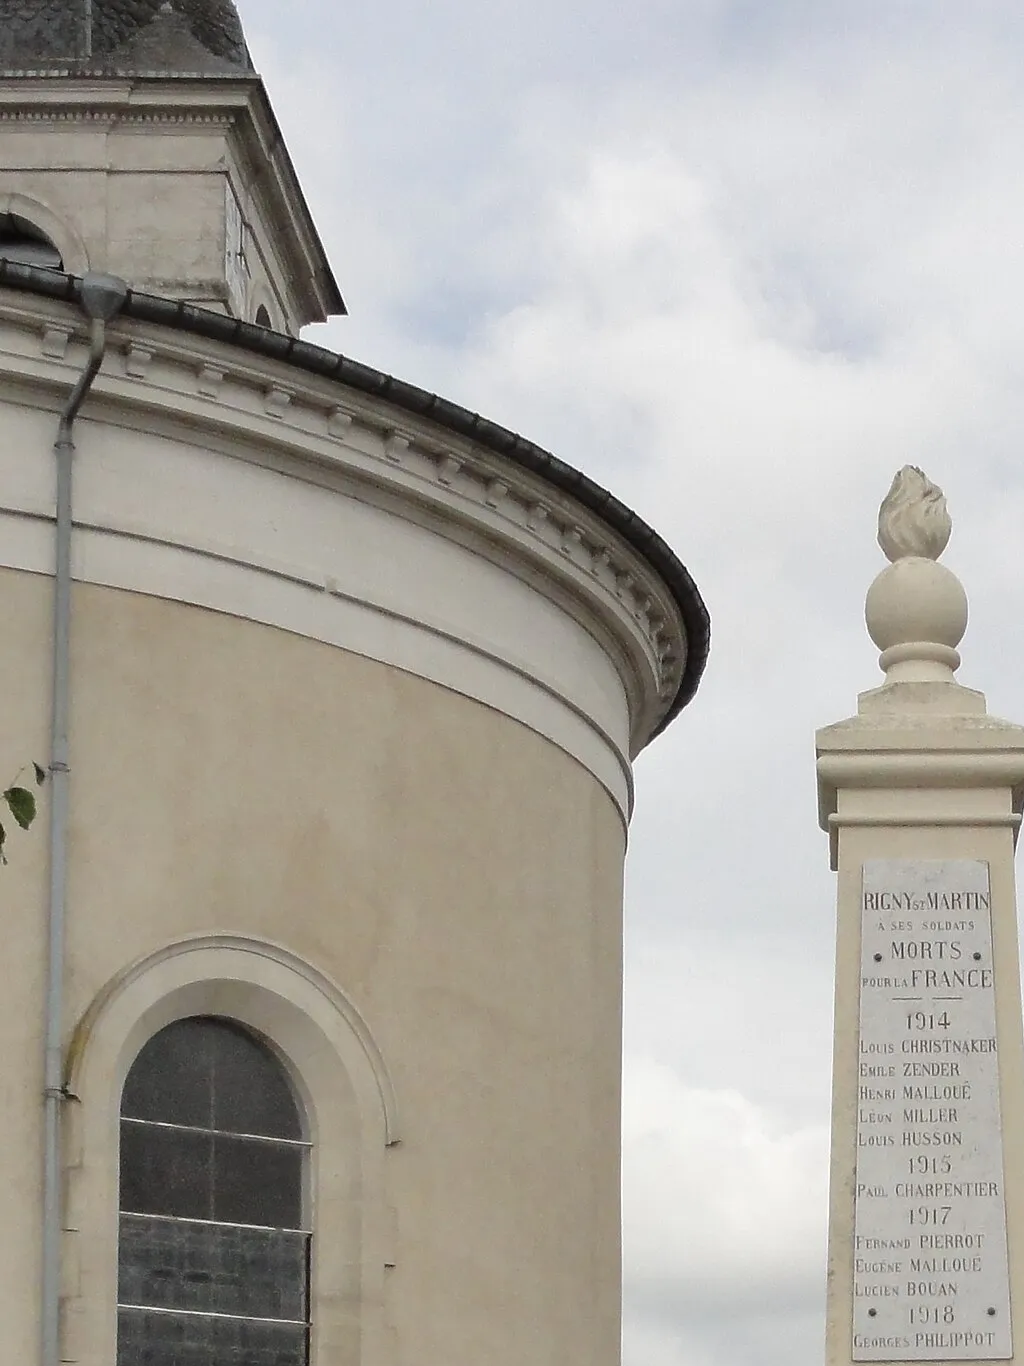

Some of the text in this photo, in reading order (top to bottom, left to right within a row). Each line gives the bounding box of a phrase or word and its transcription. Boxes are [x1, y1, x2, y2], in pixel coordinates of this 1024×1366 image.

[864, 892, 914, 910] RIGNY
[926, 892, 989, 910] MARTIN
[891, 921, 913, 931] SES
[922, 921, 975, 931] SOLDATS
[891, 941, 962, 960] MORTS
[862, 969, 992, 988] POUR LA FRANCE
[906, 1011, 950, 1030] 1914
[901, 1039, 997, 1054] CHRISTNAKER
[903, 1062, 960, 1077] ZENDER
[902, 1081, 971, 1100] MALLOUÉ
[903, 1108, 958, 1123] MILLER
[902, 1131, 962, 1146] HUSSON
[908, 1155, 952, 1174] 1915
[895, 1182, 999, 1197] CHARPENTIER
[909, 1206, 952, 1225] 1917
[920, 1234, 985, 1250] PIERROT
[910, 1254, 982, 1273] MALLOUÉ
[907, 1281, 958, 1297] BOUAN
[909, 1305, 955, 1324] 1918
[915, 1332, 995, 1348] PHILIPPOT
